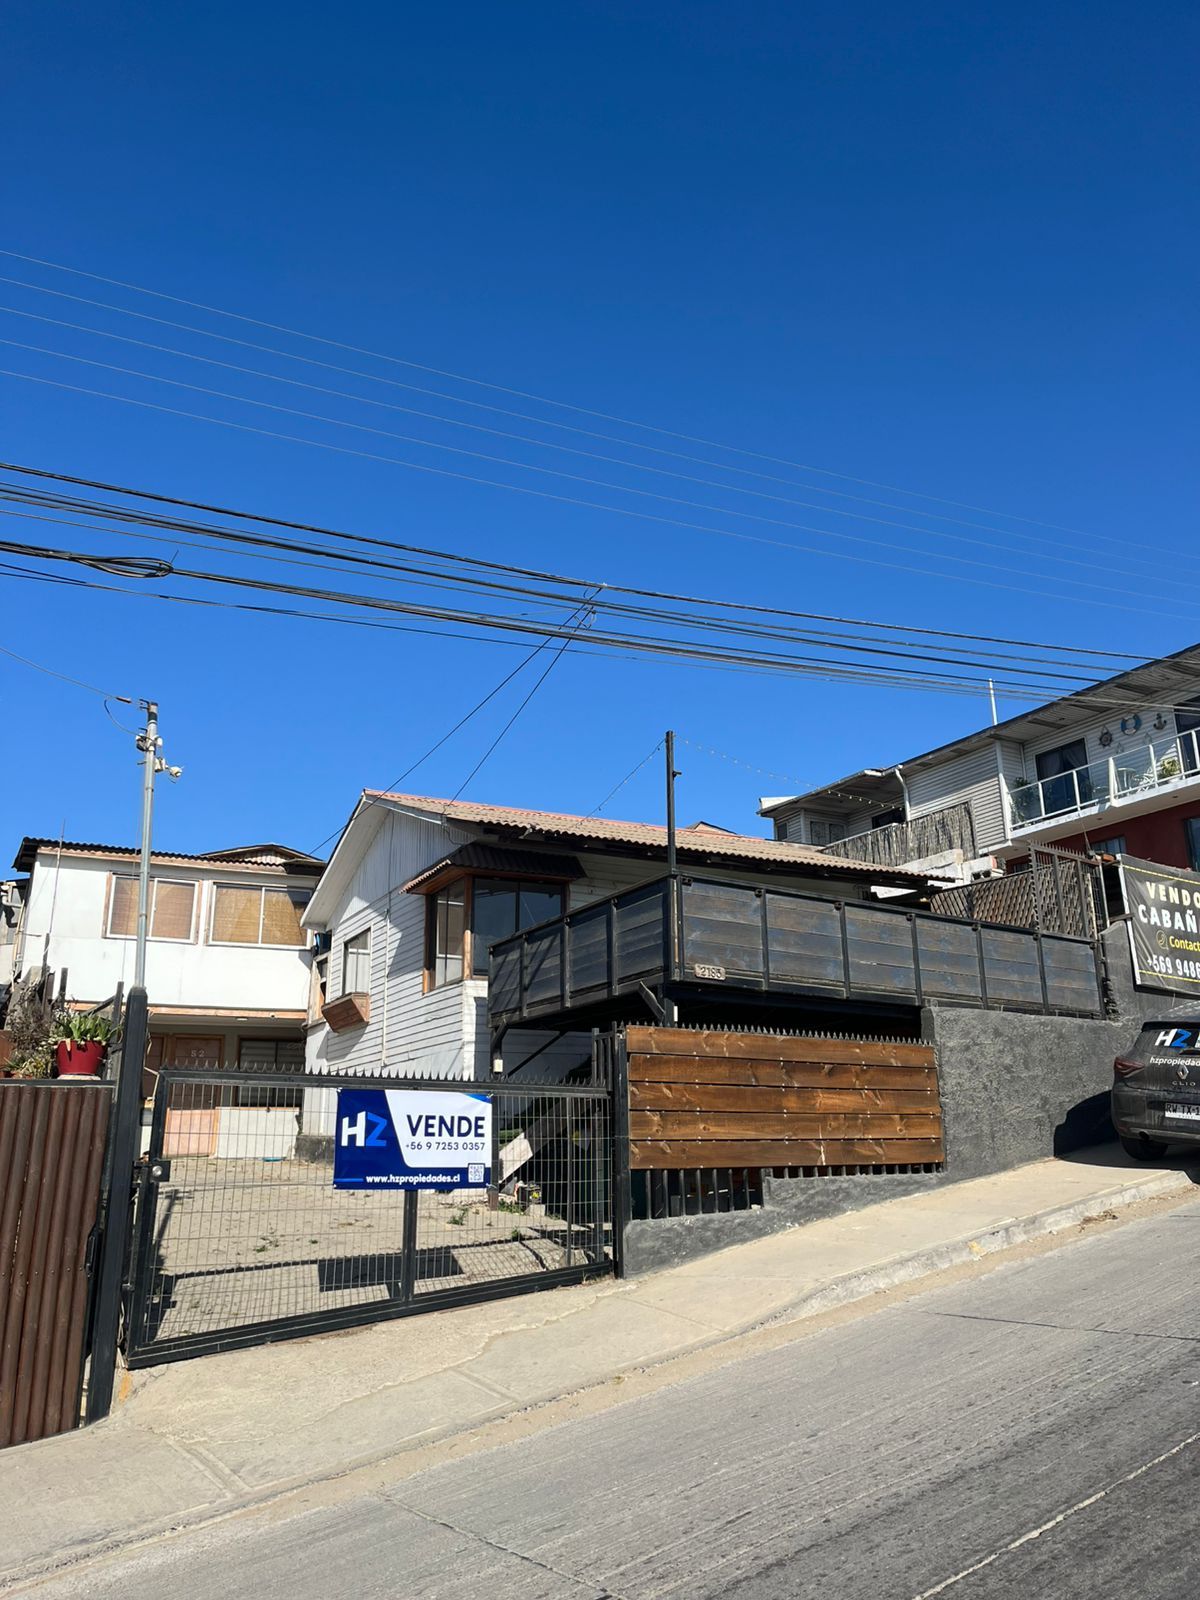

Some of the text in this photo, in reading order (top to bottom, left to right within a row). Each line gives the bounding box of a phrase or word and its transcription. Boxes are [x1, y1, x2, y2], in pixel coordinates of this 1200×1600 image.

[1145, 881, 1200, 908] VENDO
[1138, 904, 1198, 933] CABAÑ
[1147, 953, 1173, 974] +569
[1155, 1028, 1191, 1047] HZ
[341, 1111, 388, 1147] HZ
[406, 1114, 486, 1138] VENDE
[406, 1141, 485, 1151] +56 9 7253 0357
[366, 1174, 461, 1185] www.hzpropiedades.cl
